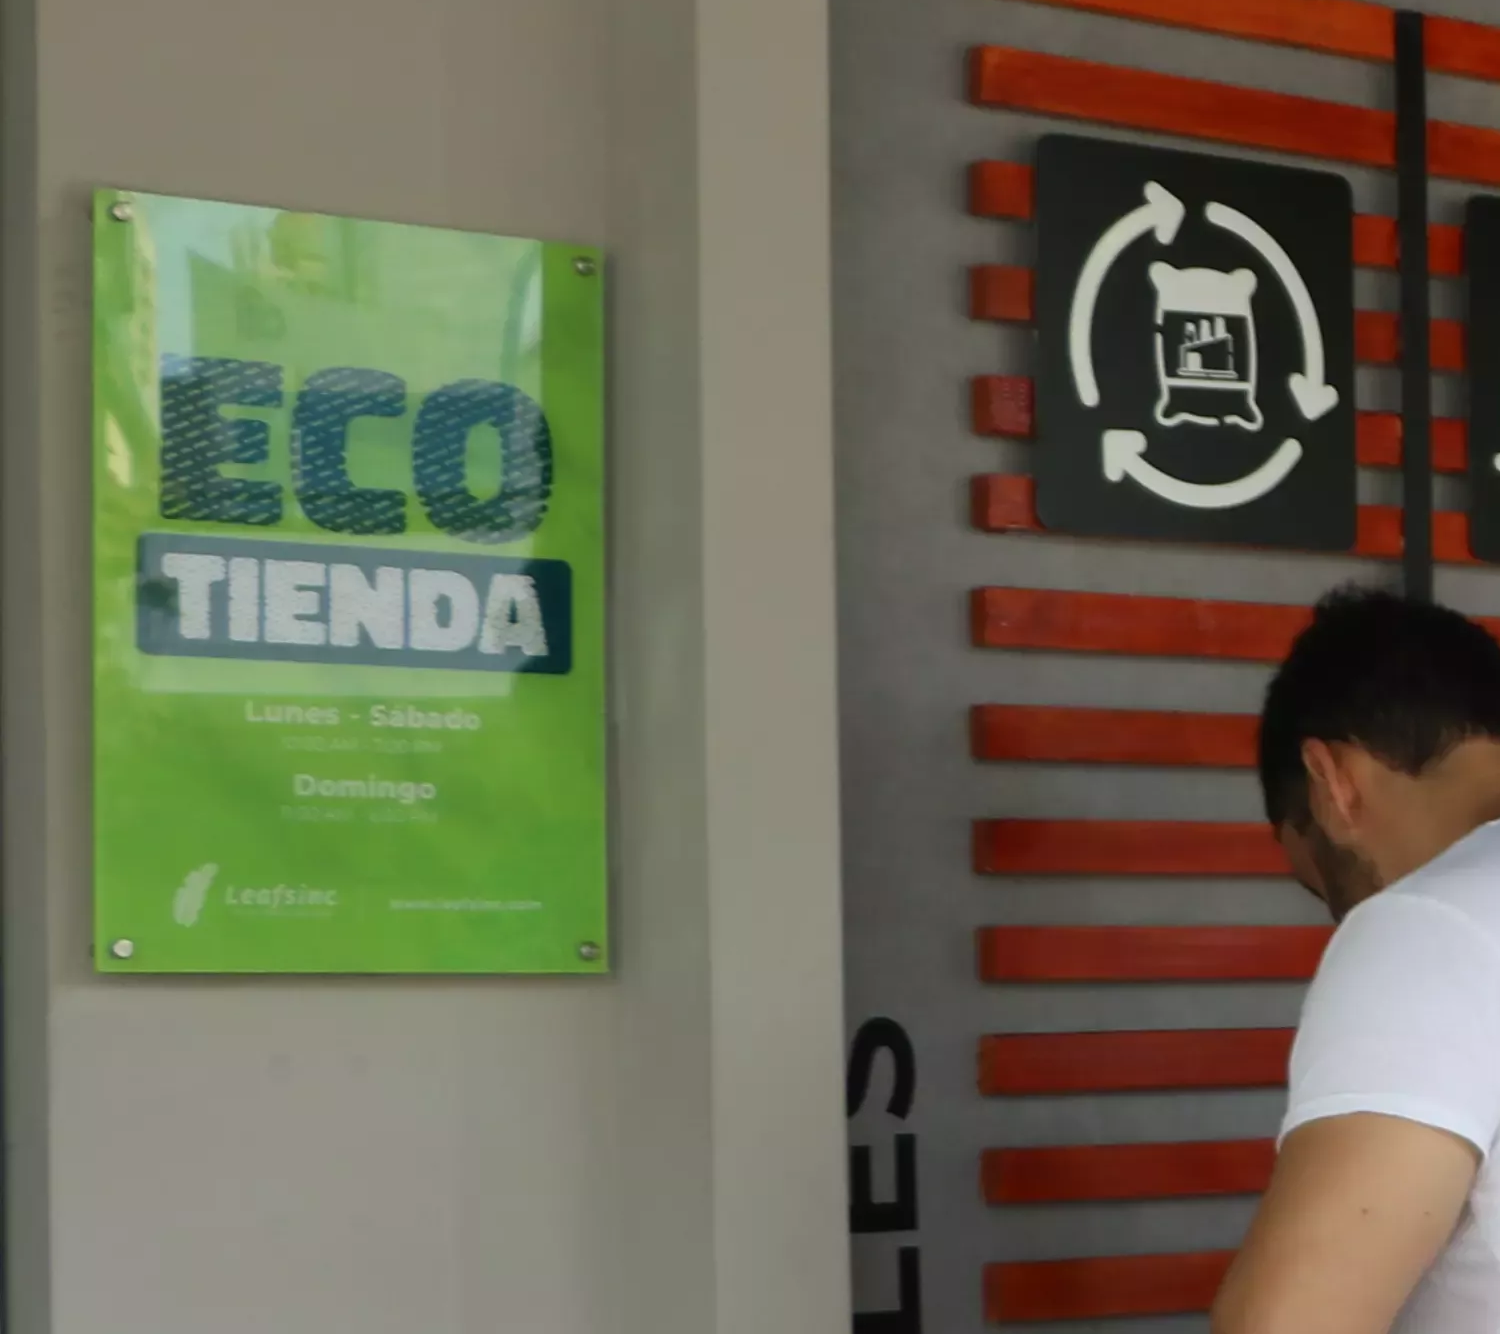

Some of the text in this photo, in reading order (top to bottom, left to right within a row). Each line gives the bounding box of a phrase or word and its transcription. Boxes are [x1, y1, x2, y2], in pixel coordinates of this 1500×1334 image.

[160, 352, 554, 545] ECO
[161, 552, 549, 656] TIENDA
[244, 699, 341, 725] Lunes
[293, 772, 437, 805] Domingo
